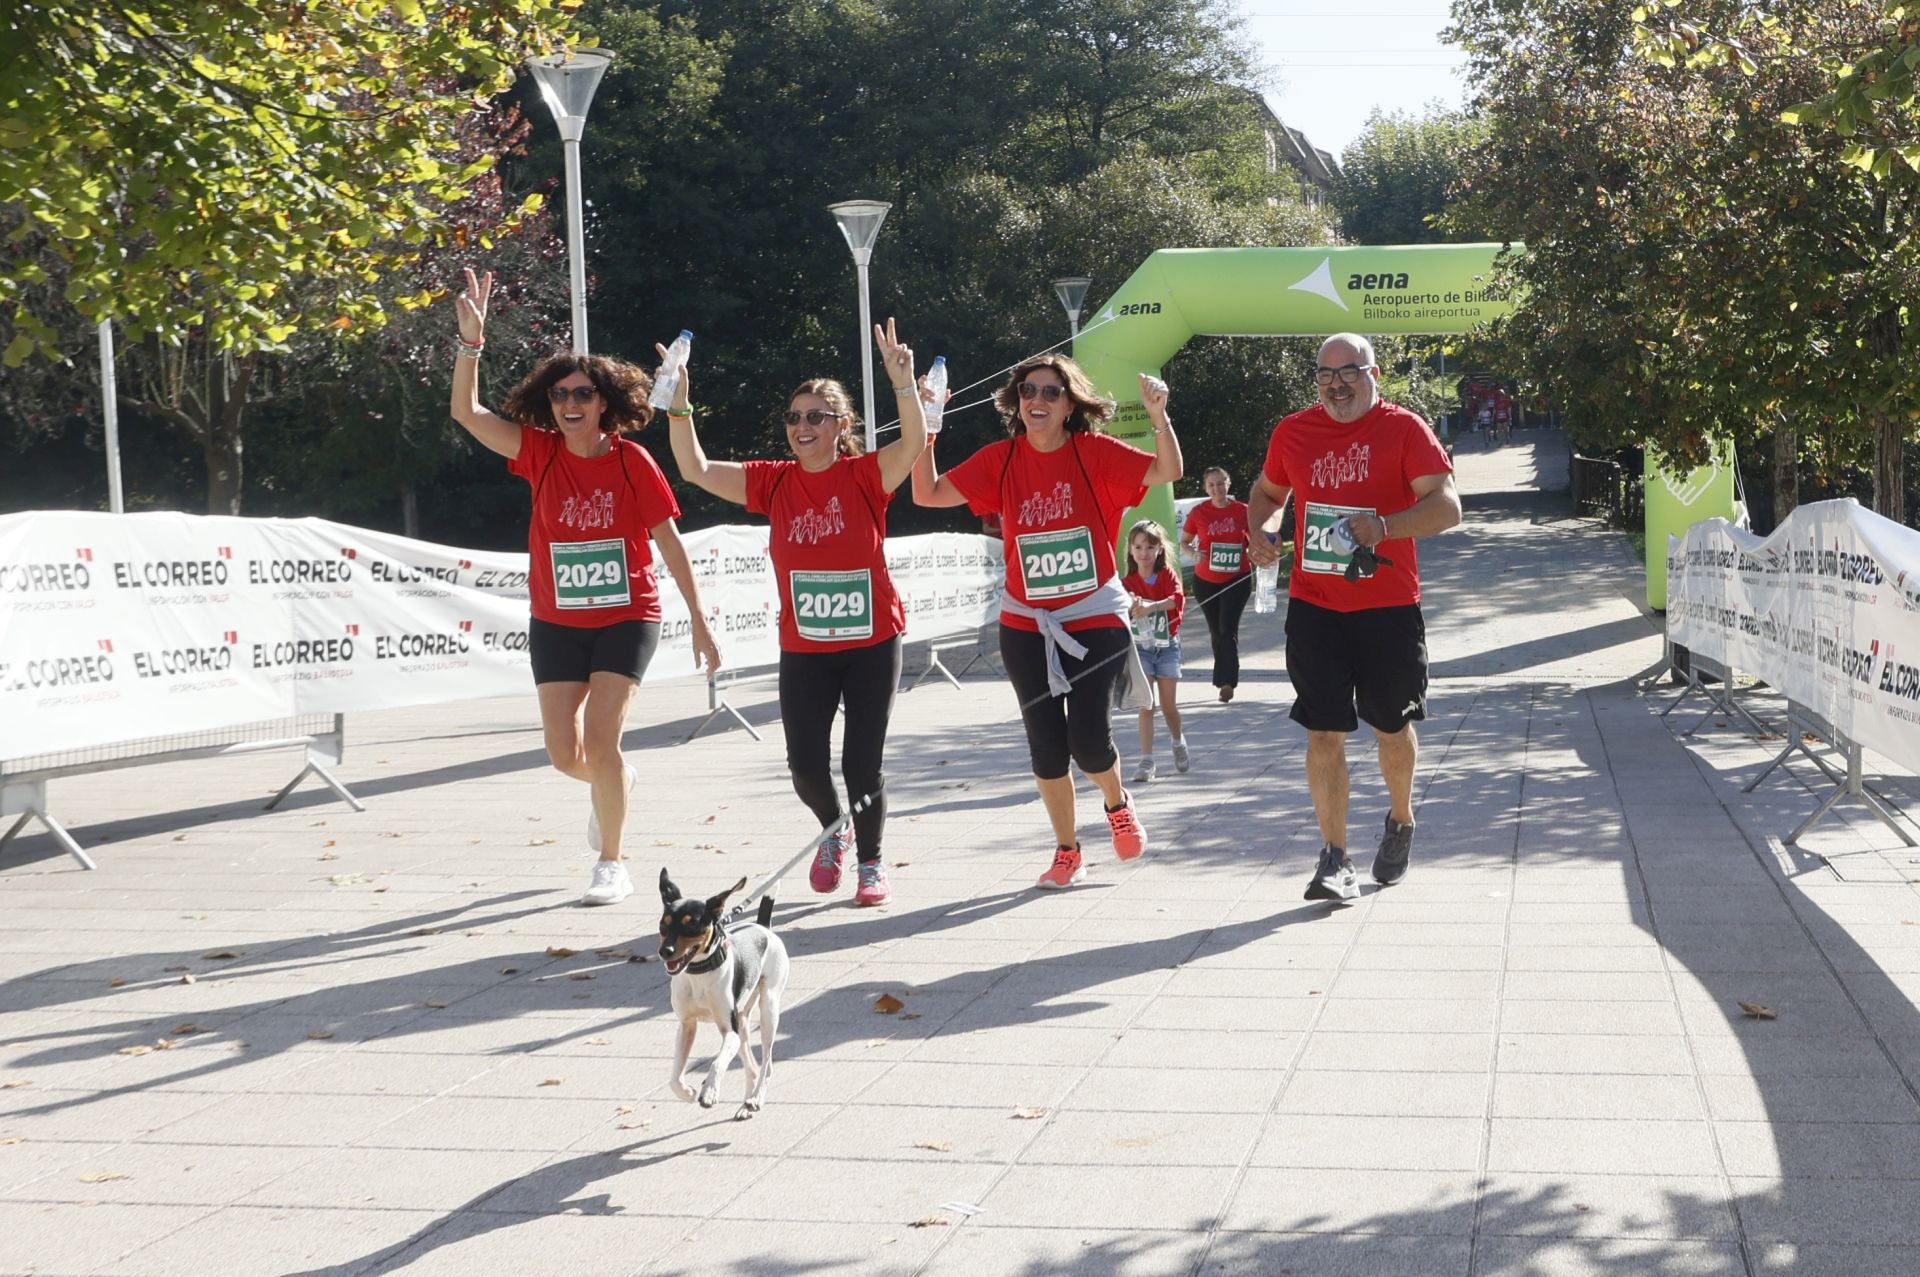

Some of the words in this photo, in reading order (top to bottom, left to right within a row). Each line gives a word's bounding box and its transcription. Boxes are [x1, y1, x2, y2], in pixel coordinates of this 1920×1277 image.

[1347, 272, 1409, 290] aena
[1119, 302, 1162, 316] aena
[1363, 292, 1440, 307] Aeropuerto
[1443, 291, 1461, 303] de
[1364, 308, 1411, 320] Bilboko
[1414, 307, 1481, 320] aireportua
[1306, 525, 1333, 552] 20
[1025, 547, 1089, 578] 2029
[1212, 551, 1241, 563] 2018
[144, 560, 228, 587] CORREO
[271, 559, 352, 583] CORREO
[557, 560, 621, 588] 2029
[798, 591, 865, 618] 2029
[275, 637, 354, 665] CORREO
[400, 633, 470, 657] CORREO
[28, 654, 114, 688] CORREO
